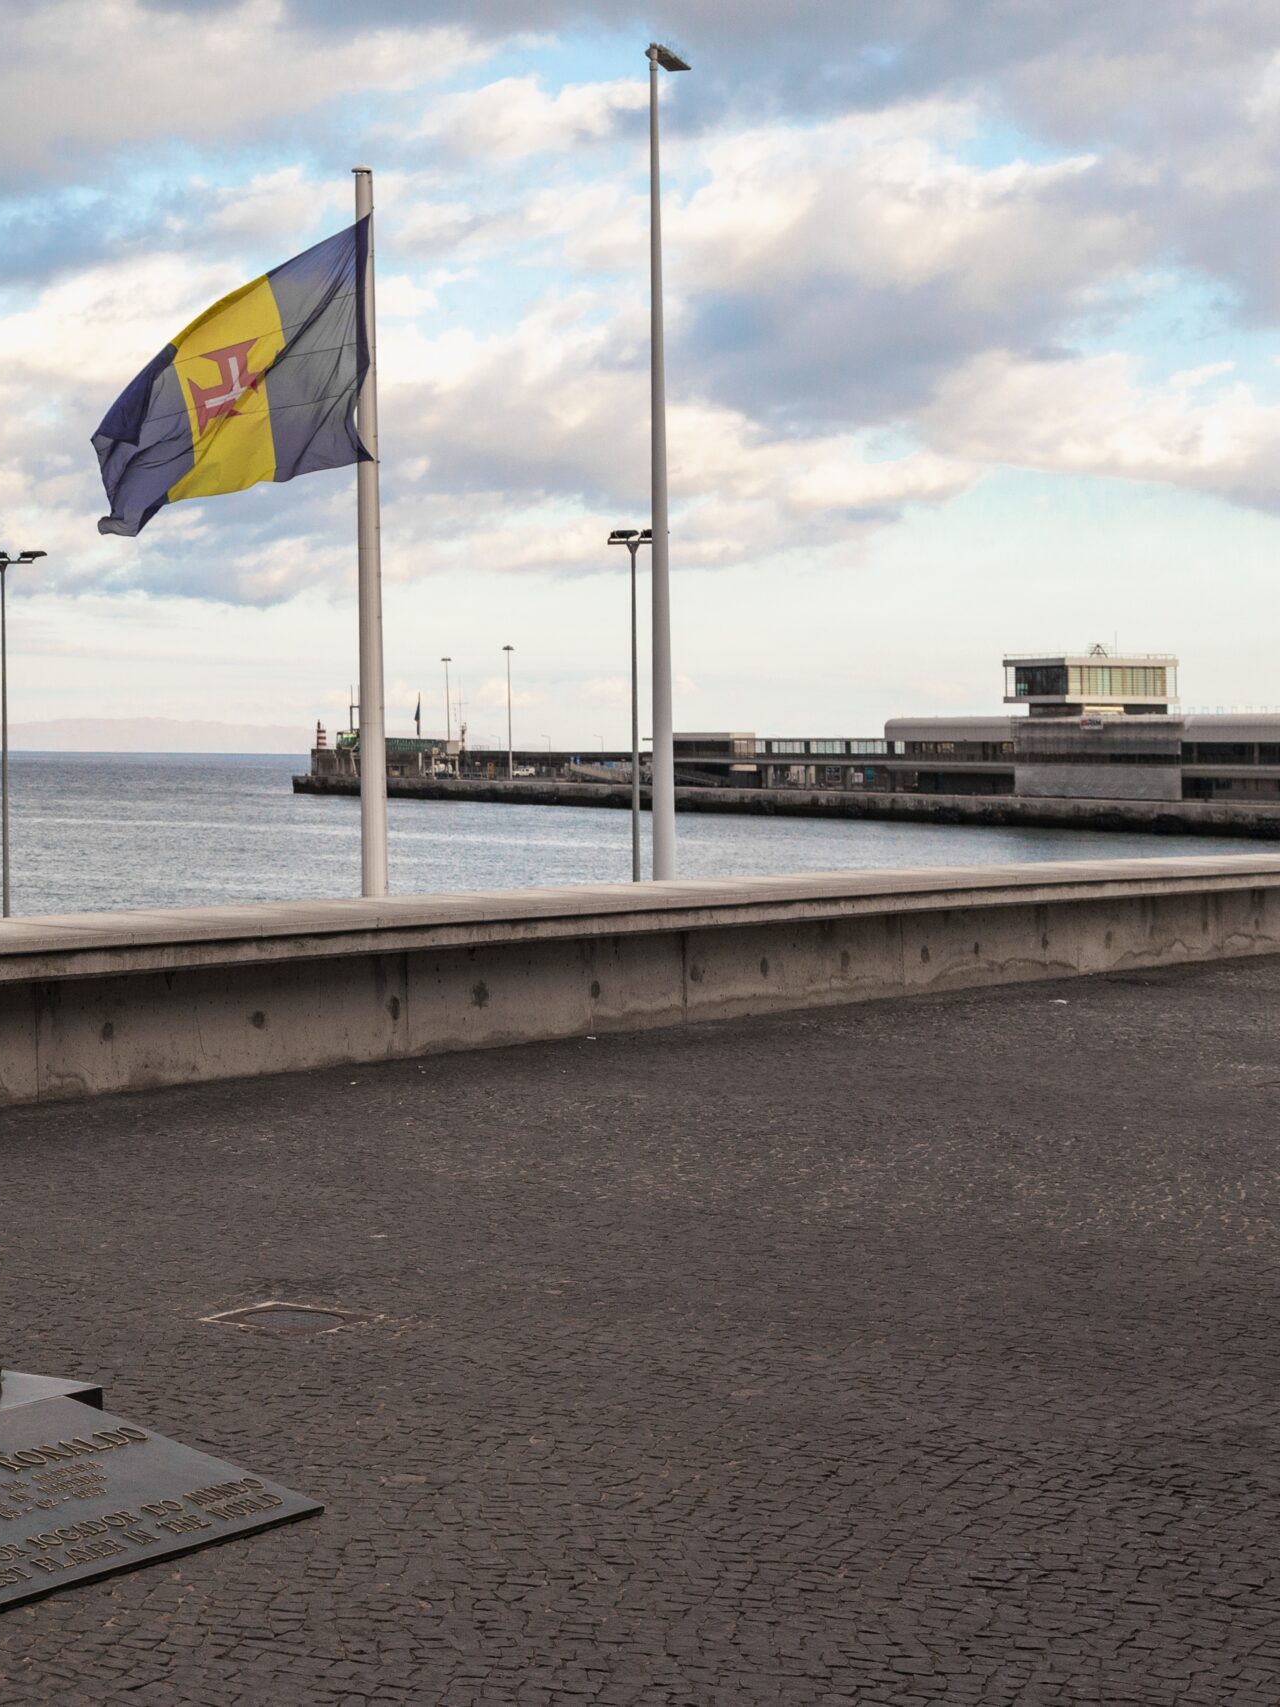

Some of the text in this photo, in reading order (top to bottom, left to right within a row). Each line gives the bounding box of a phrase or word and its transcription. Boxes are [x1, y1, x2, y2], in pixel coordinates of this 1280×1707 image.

[9, 1491, 35, 1503] IN
[37, 1472, 107, 1494] MADEIRA
[32, 1460, 104, 1483] MADEIRA
[26, 1511, 142, 1550] JOGADOR
[140, 1499, 184, 1517] DO
[183, 1477, 264, 1506] MUNDO
[30, 1539, 128, 1572] PLAYER
[123, 1527, 161, 1546] IN
[155, 1514, 212, 1534] THE
[205, 1493, 283, 1521] WORLD
